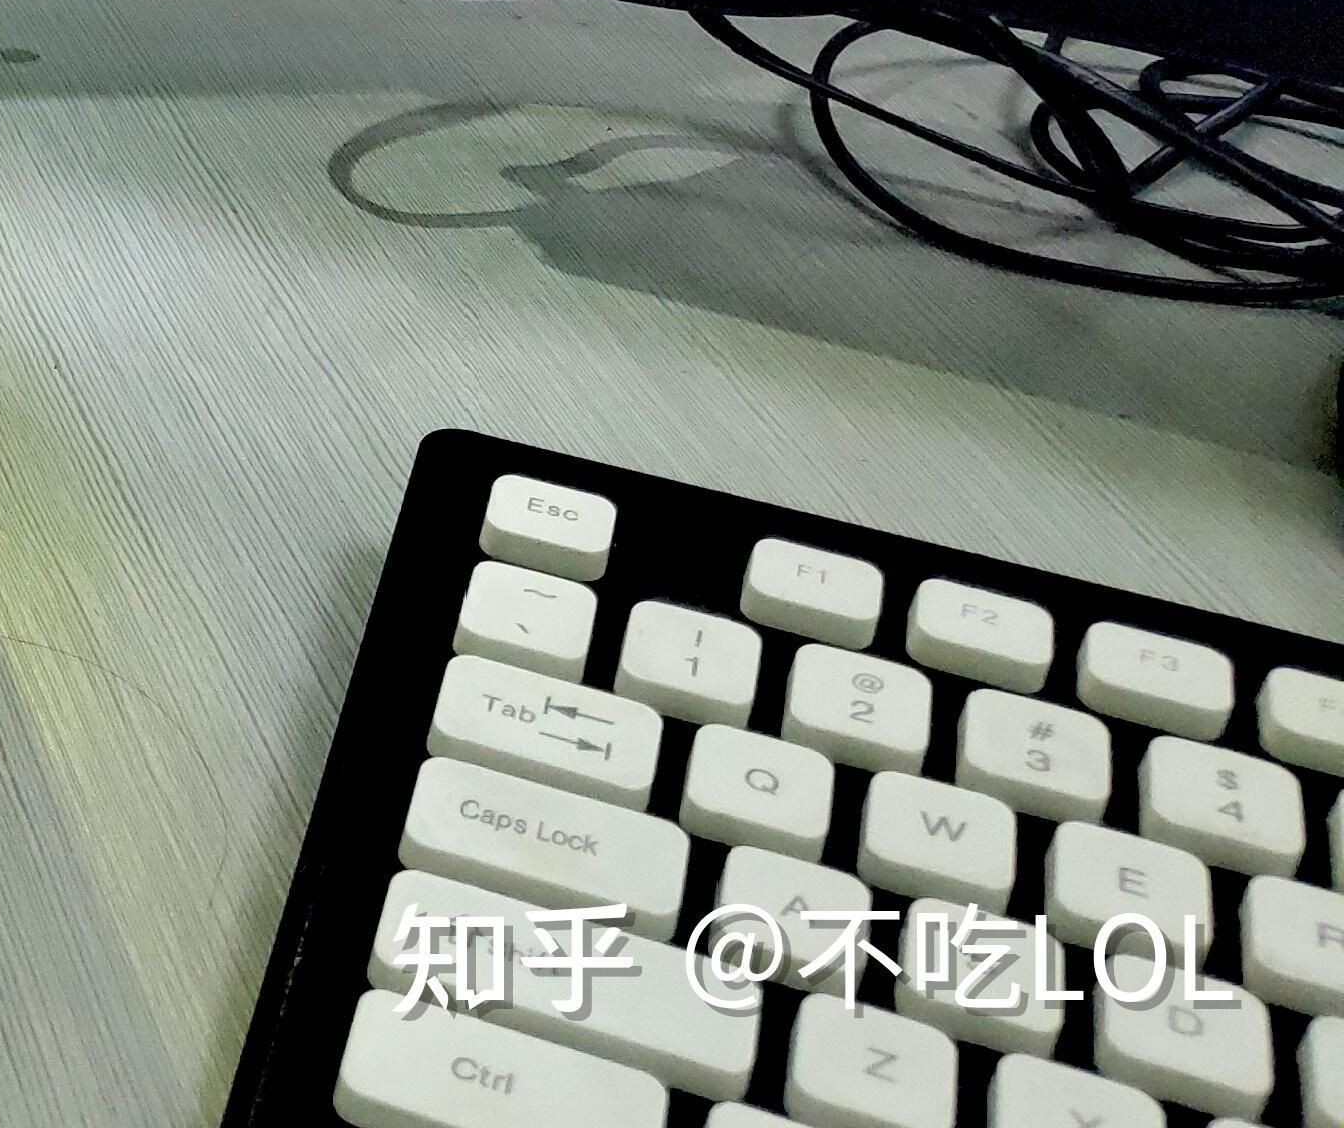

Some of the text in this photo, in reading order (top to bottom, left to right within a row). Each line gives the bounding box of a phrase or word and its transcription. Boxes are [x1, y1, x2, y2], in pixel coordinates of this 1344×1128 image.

[527, 497, 580, 522] Esc
[796, 564, 826, 585] F1
[960, 603, 1000, 626] F2
[684, 656, 699, 677] 1
[1139, 648, 1179, 672] F3
[483, 694, 537, 723] Tab
[849, 700, 875, 724] 2
[1025, 749, 1051, 772] 3
[744, 768, 780, 796] Q
[1216, 800, 1244, 823] 4
[460, 798, 600, 856] Caps Lock
[921, 810, 967, 843] W
[1118, 867, 1150, 900] E
[1168, 1004, 1204, 1036] D
[450, 1056, 515, 1095] Ctrl
[864, 1046, 898, 1083] Z
